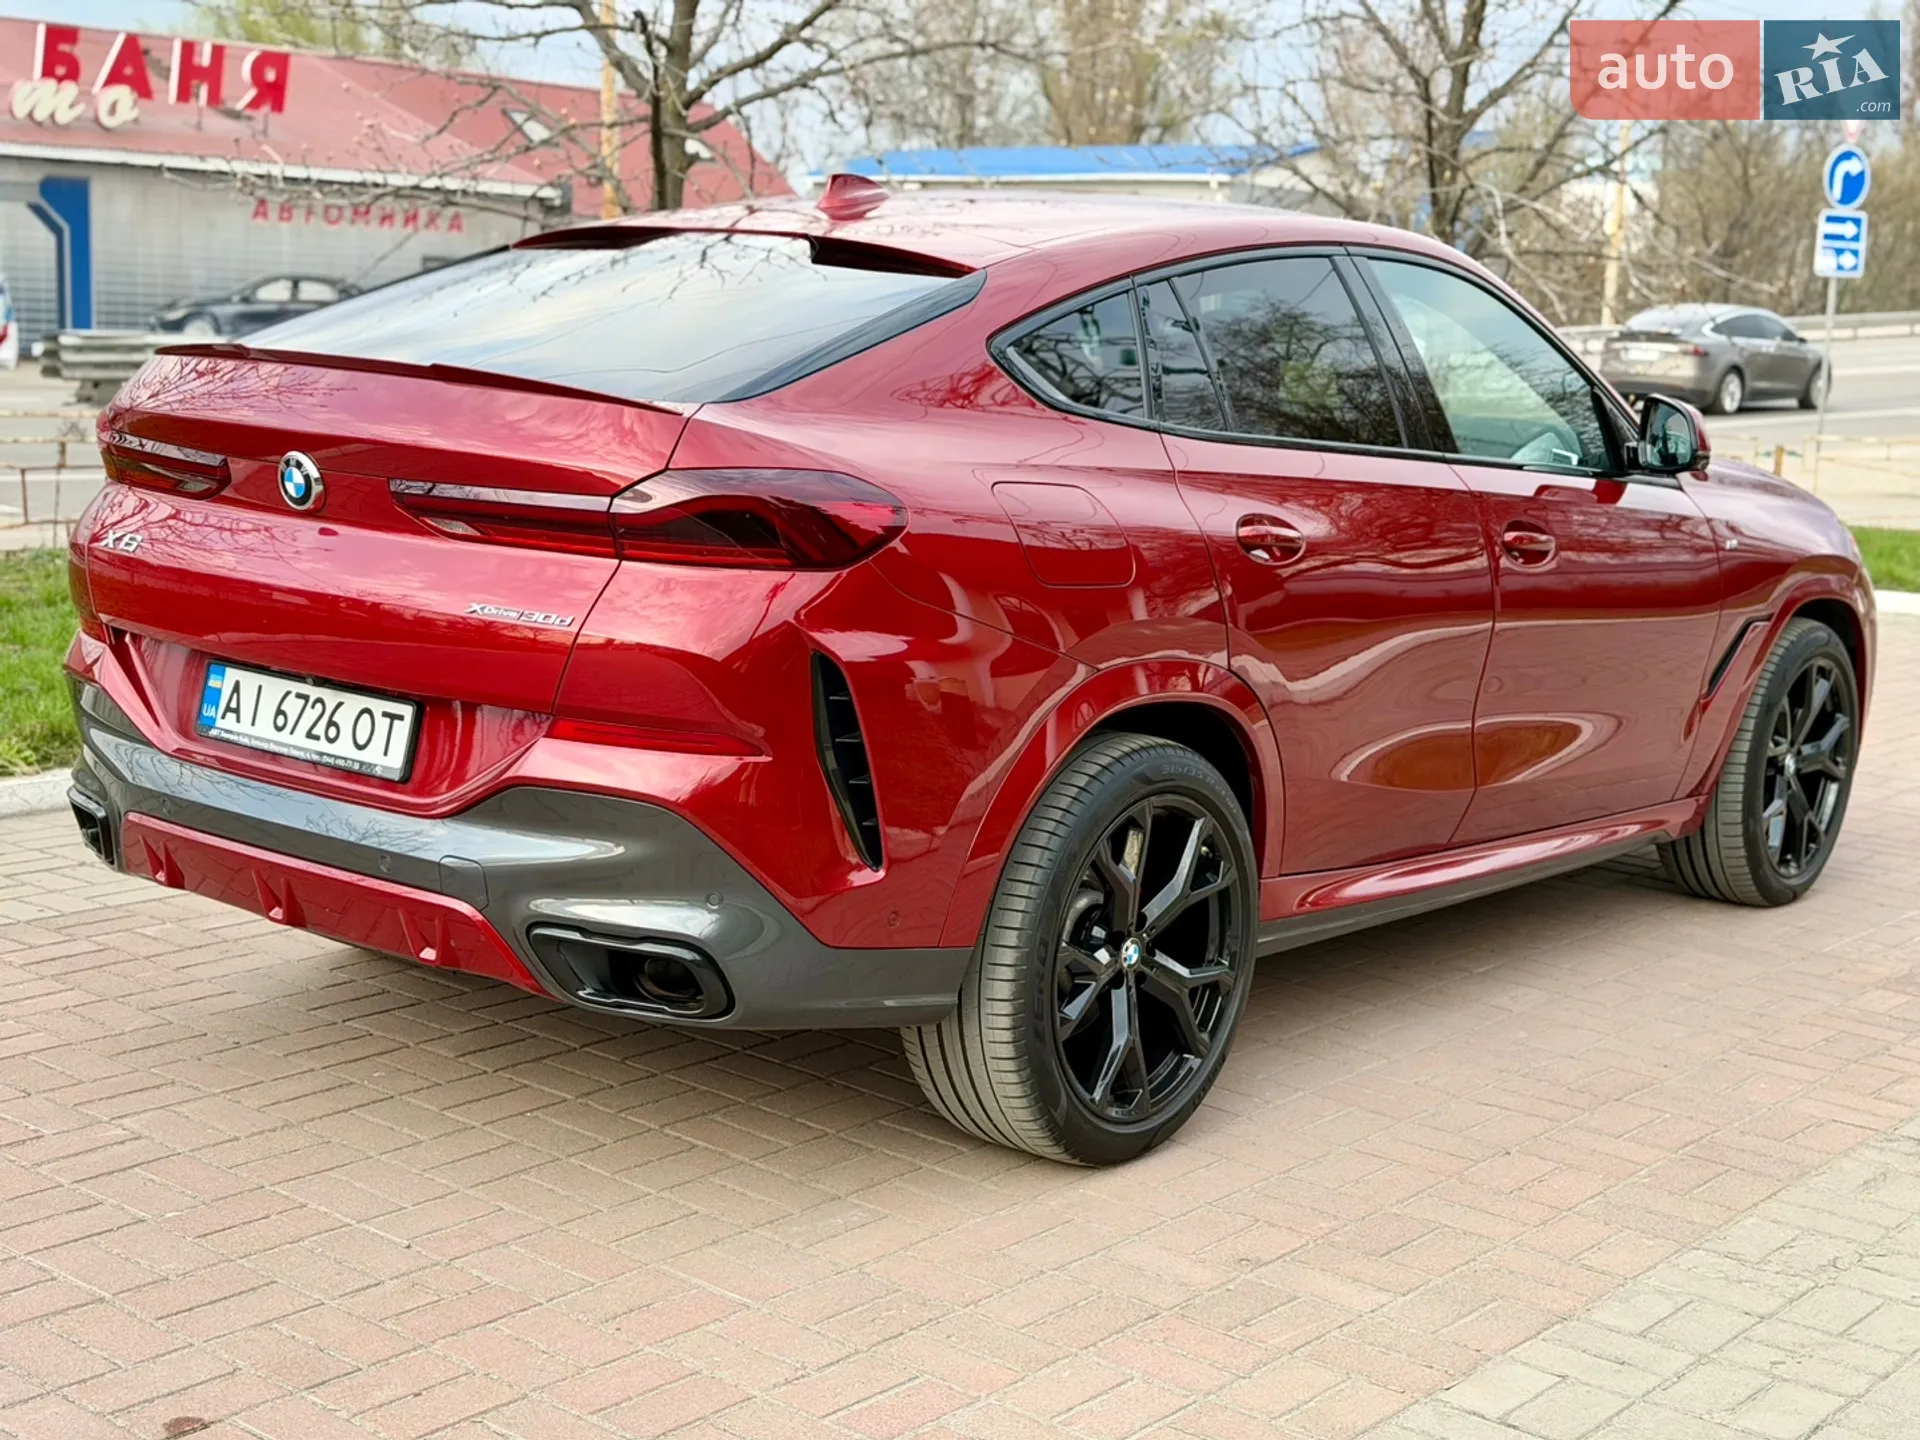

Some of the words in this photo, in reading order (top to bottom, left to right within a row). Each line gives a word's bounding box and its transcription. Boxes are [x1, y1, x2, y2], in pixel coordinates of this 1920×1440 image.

[32, 22, 291, 114] БАНЯ
[100, 530, 143, 552] X6
[202, 702, 216, 719] UA
[220, 679, 262, 727] AI
[273, 690, 345, 744] 6726
[352, 707, 405, 757] OT
